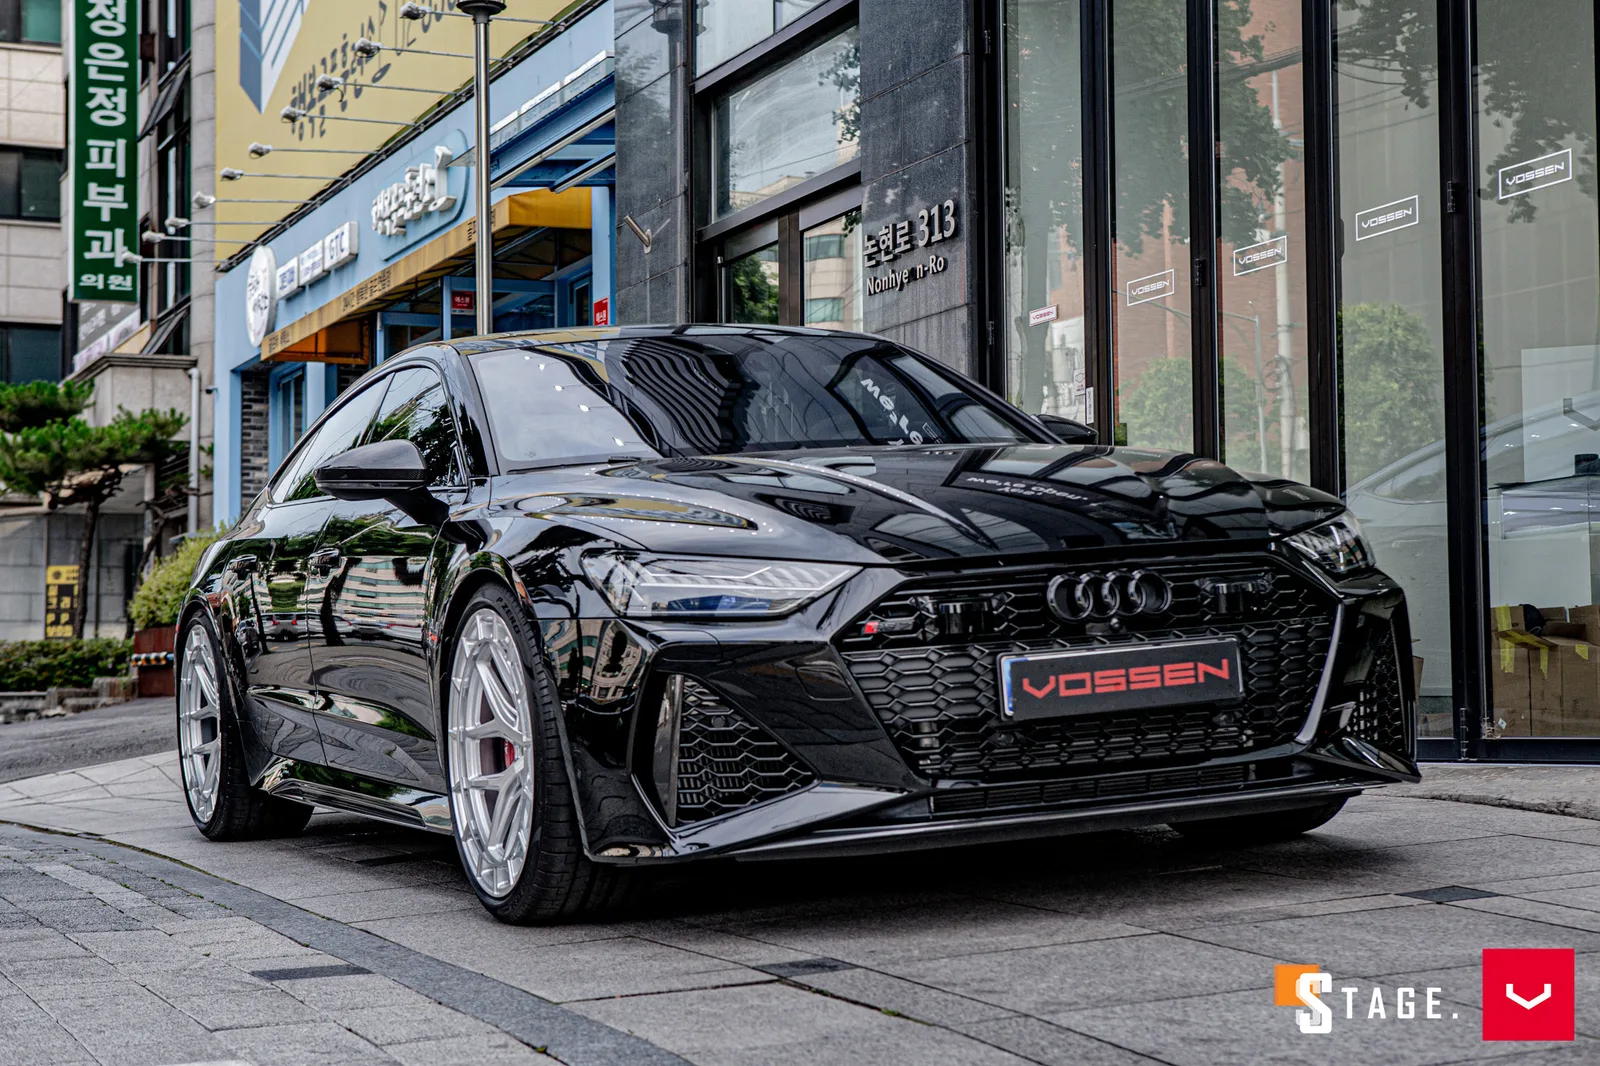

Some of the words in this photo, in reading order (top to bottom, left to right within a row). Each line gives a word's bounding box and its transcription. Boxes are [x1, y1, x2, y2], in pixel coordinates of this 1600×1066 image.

[83, 0, 129, 127] 정은정
[1505, 160, 1565, 187] VOSSEN
[83, 138, 129, 268] 피부과
[1361, 206, 1413, 229] VOSSEN
[329, 231, 345, 260] GTC
[863, 219, 912, 268] 논현로
[917, 199, 956, 247] 313
[1238, 245, 1282, 266] VOSSEN
[79, 273, 133, 292] 의원
[1131, 278, 1170, 297] VOSSEN
[1022, 658, 1230, 699] VOSSEN
